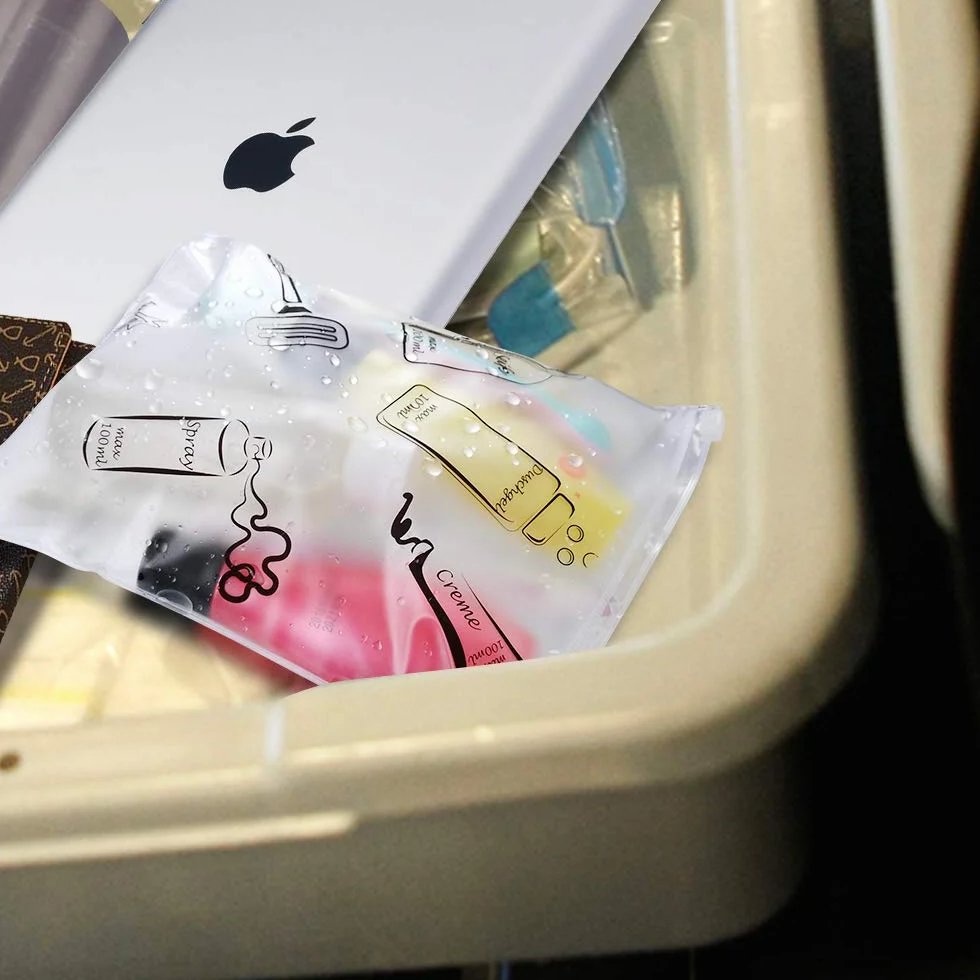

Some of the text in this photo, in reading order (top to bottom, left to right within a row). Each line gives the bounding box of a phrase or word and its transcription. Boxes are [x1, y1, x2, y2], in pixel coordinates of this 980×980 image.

[415, 404, 438, 423] max
[95, 423, 112, 468] 100ml
[112, 427, 125, 461] max
[178, 418, 201, 471] Spray
[495, 463, 544, 514] Duschgel
[436, 569, 482, 631] Creme
[467, 640, 505, 666] 100ml
